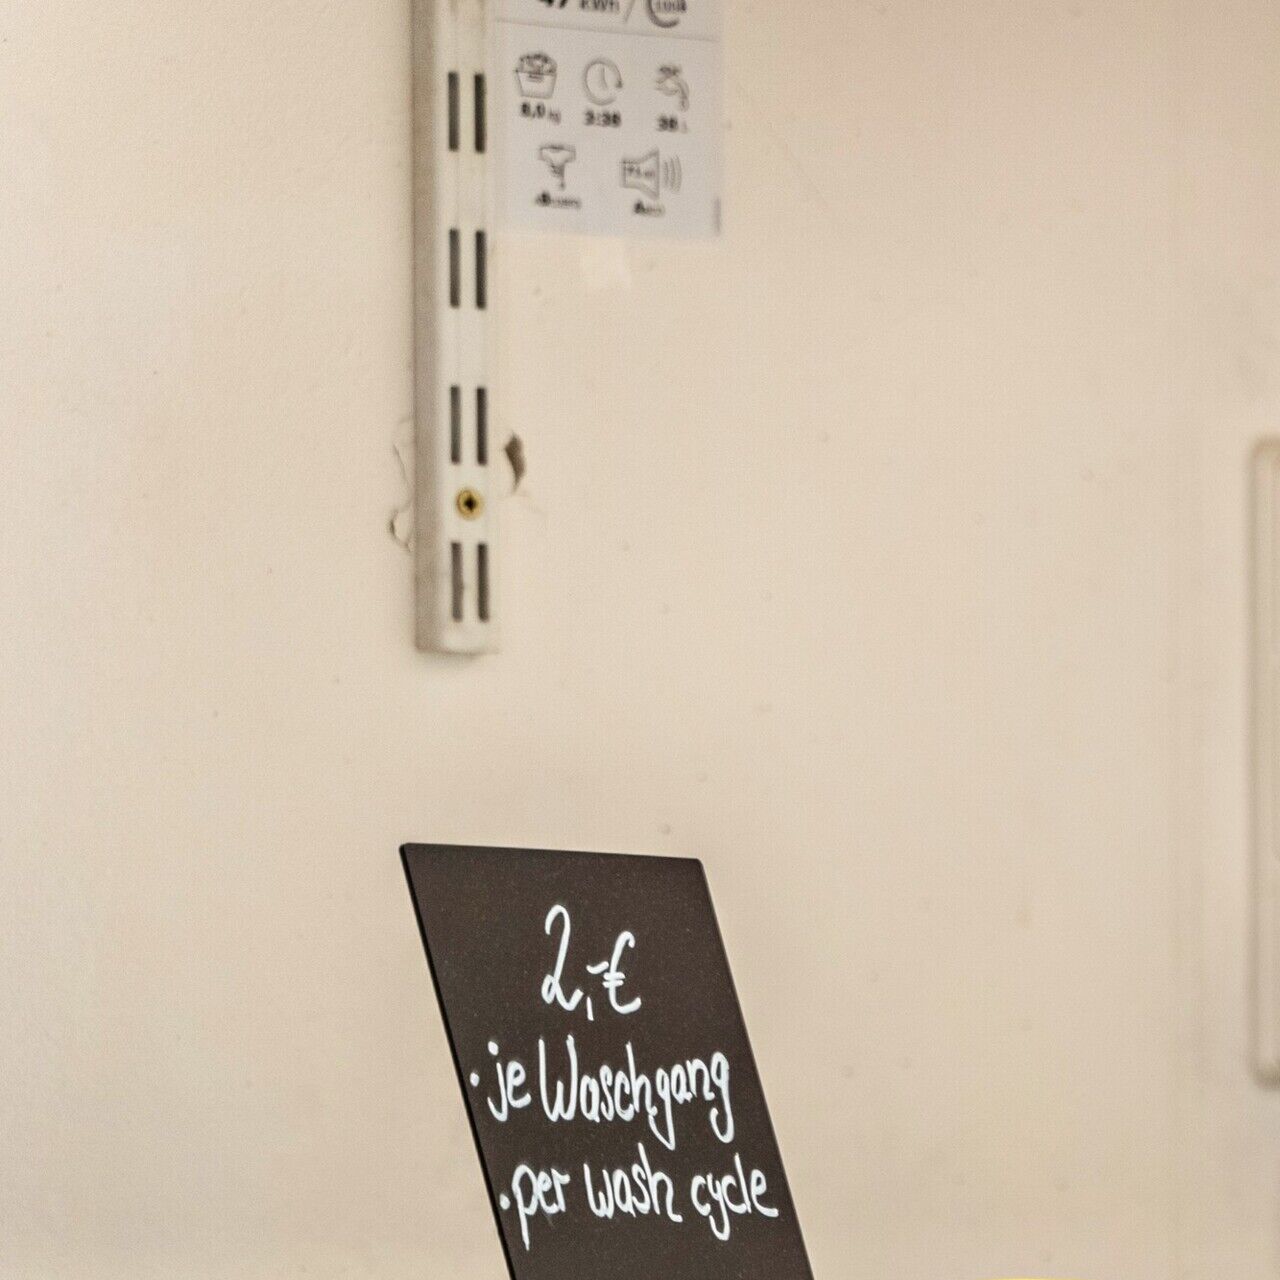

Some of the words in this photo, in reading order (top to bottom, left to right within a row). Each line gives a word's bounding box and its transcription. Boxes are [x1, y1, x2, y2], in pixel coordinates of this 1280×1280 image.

[487, 1041, 532, 1122] je
[538, 1034, 735, 1150] Waschgang
[511, 1164, 571, 1251] per
[691, 1152, 779, 1241] cycle
